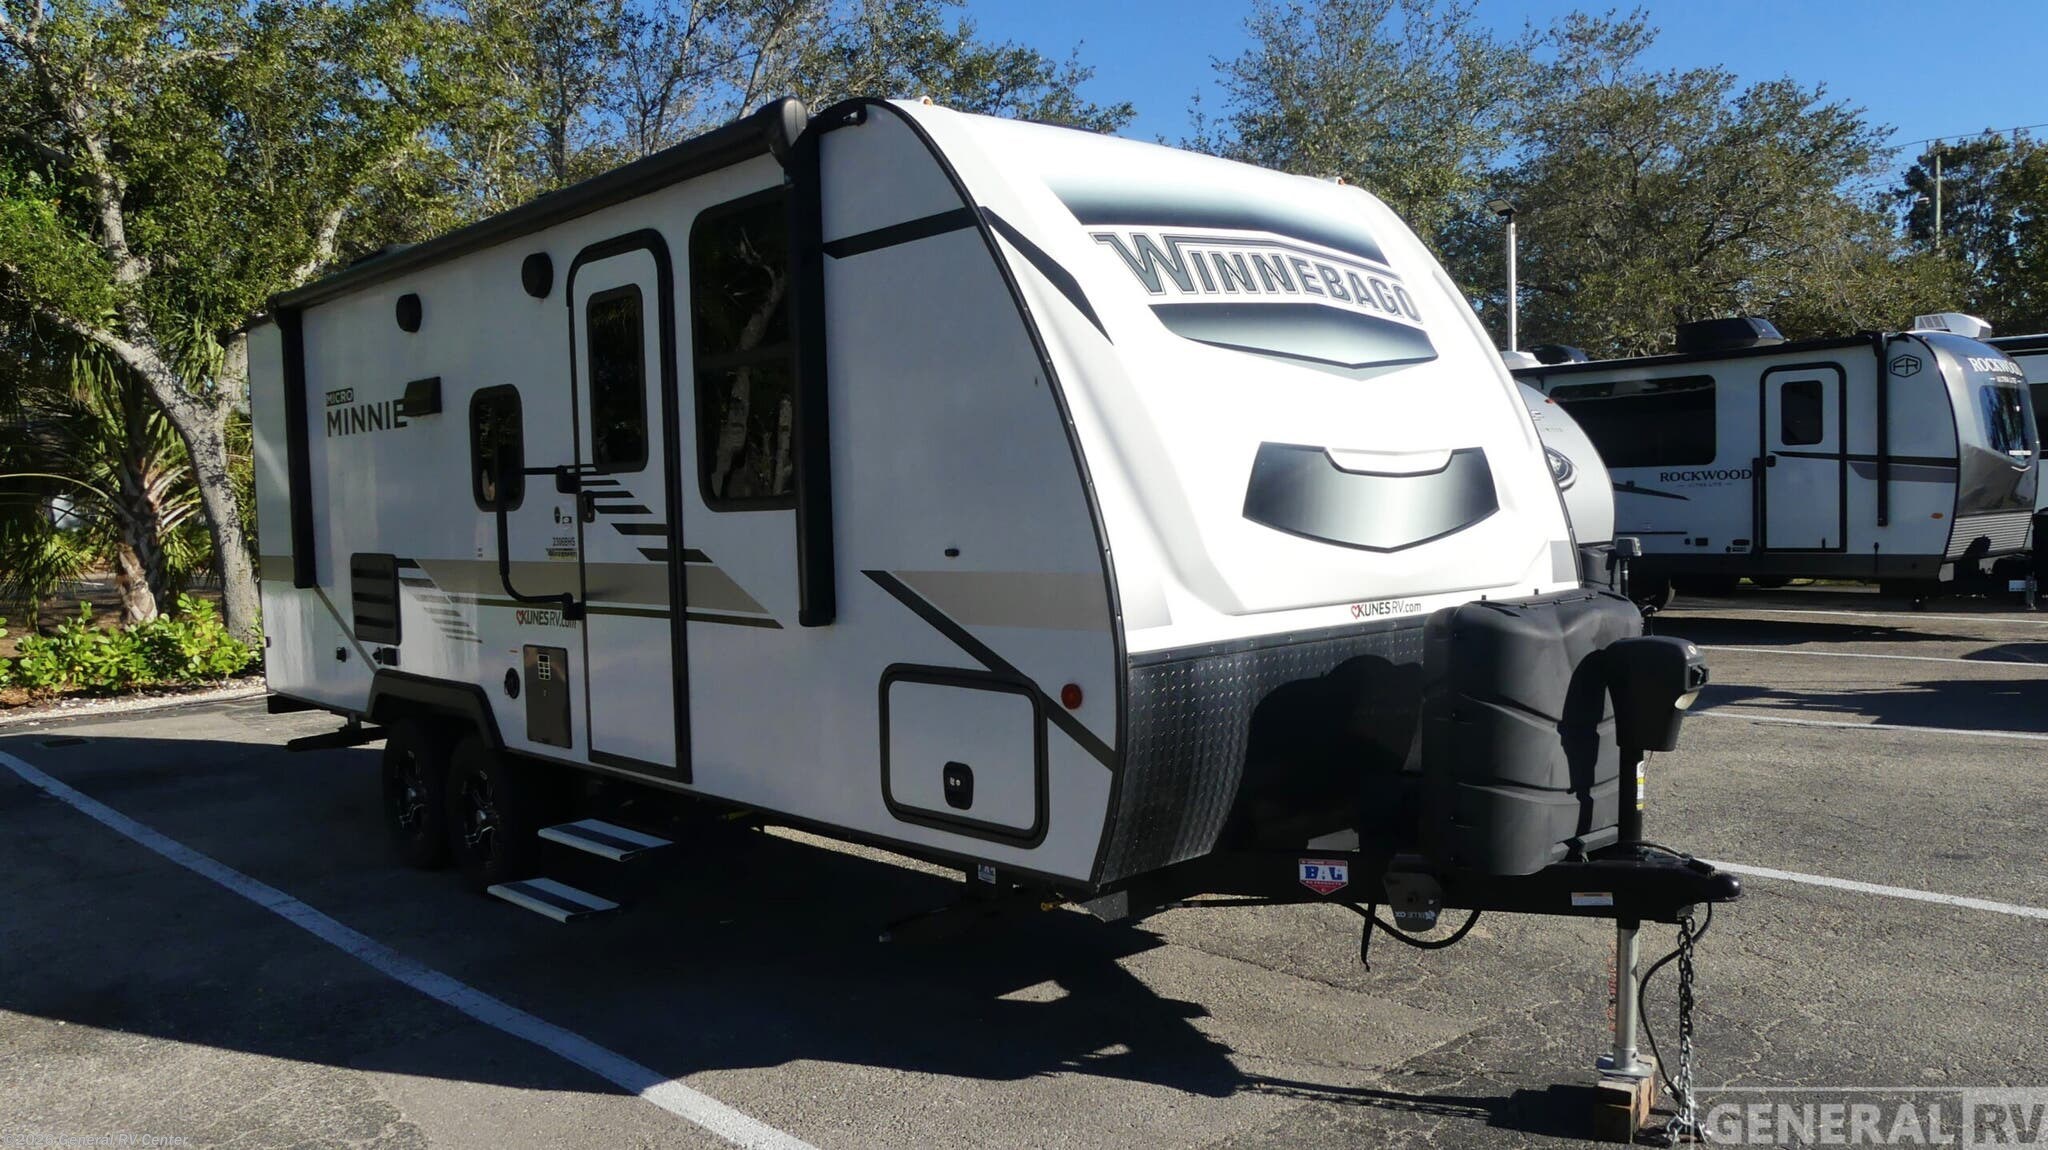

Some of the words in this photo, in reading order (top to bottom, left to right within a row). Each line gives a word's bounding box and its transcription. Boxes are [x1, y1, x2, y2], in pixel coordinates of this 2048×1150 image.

[1088, 231, 1424, 324] WINNEBAGO
[325, 388, 354, 406] MICRO
[326, 399, 408, 437] MINNIE
[1660, 468, 1753, 483] ROCKWOOD
